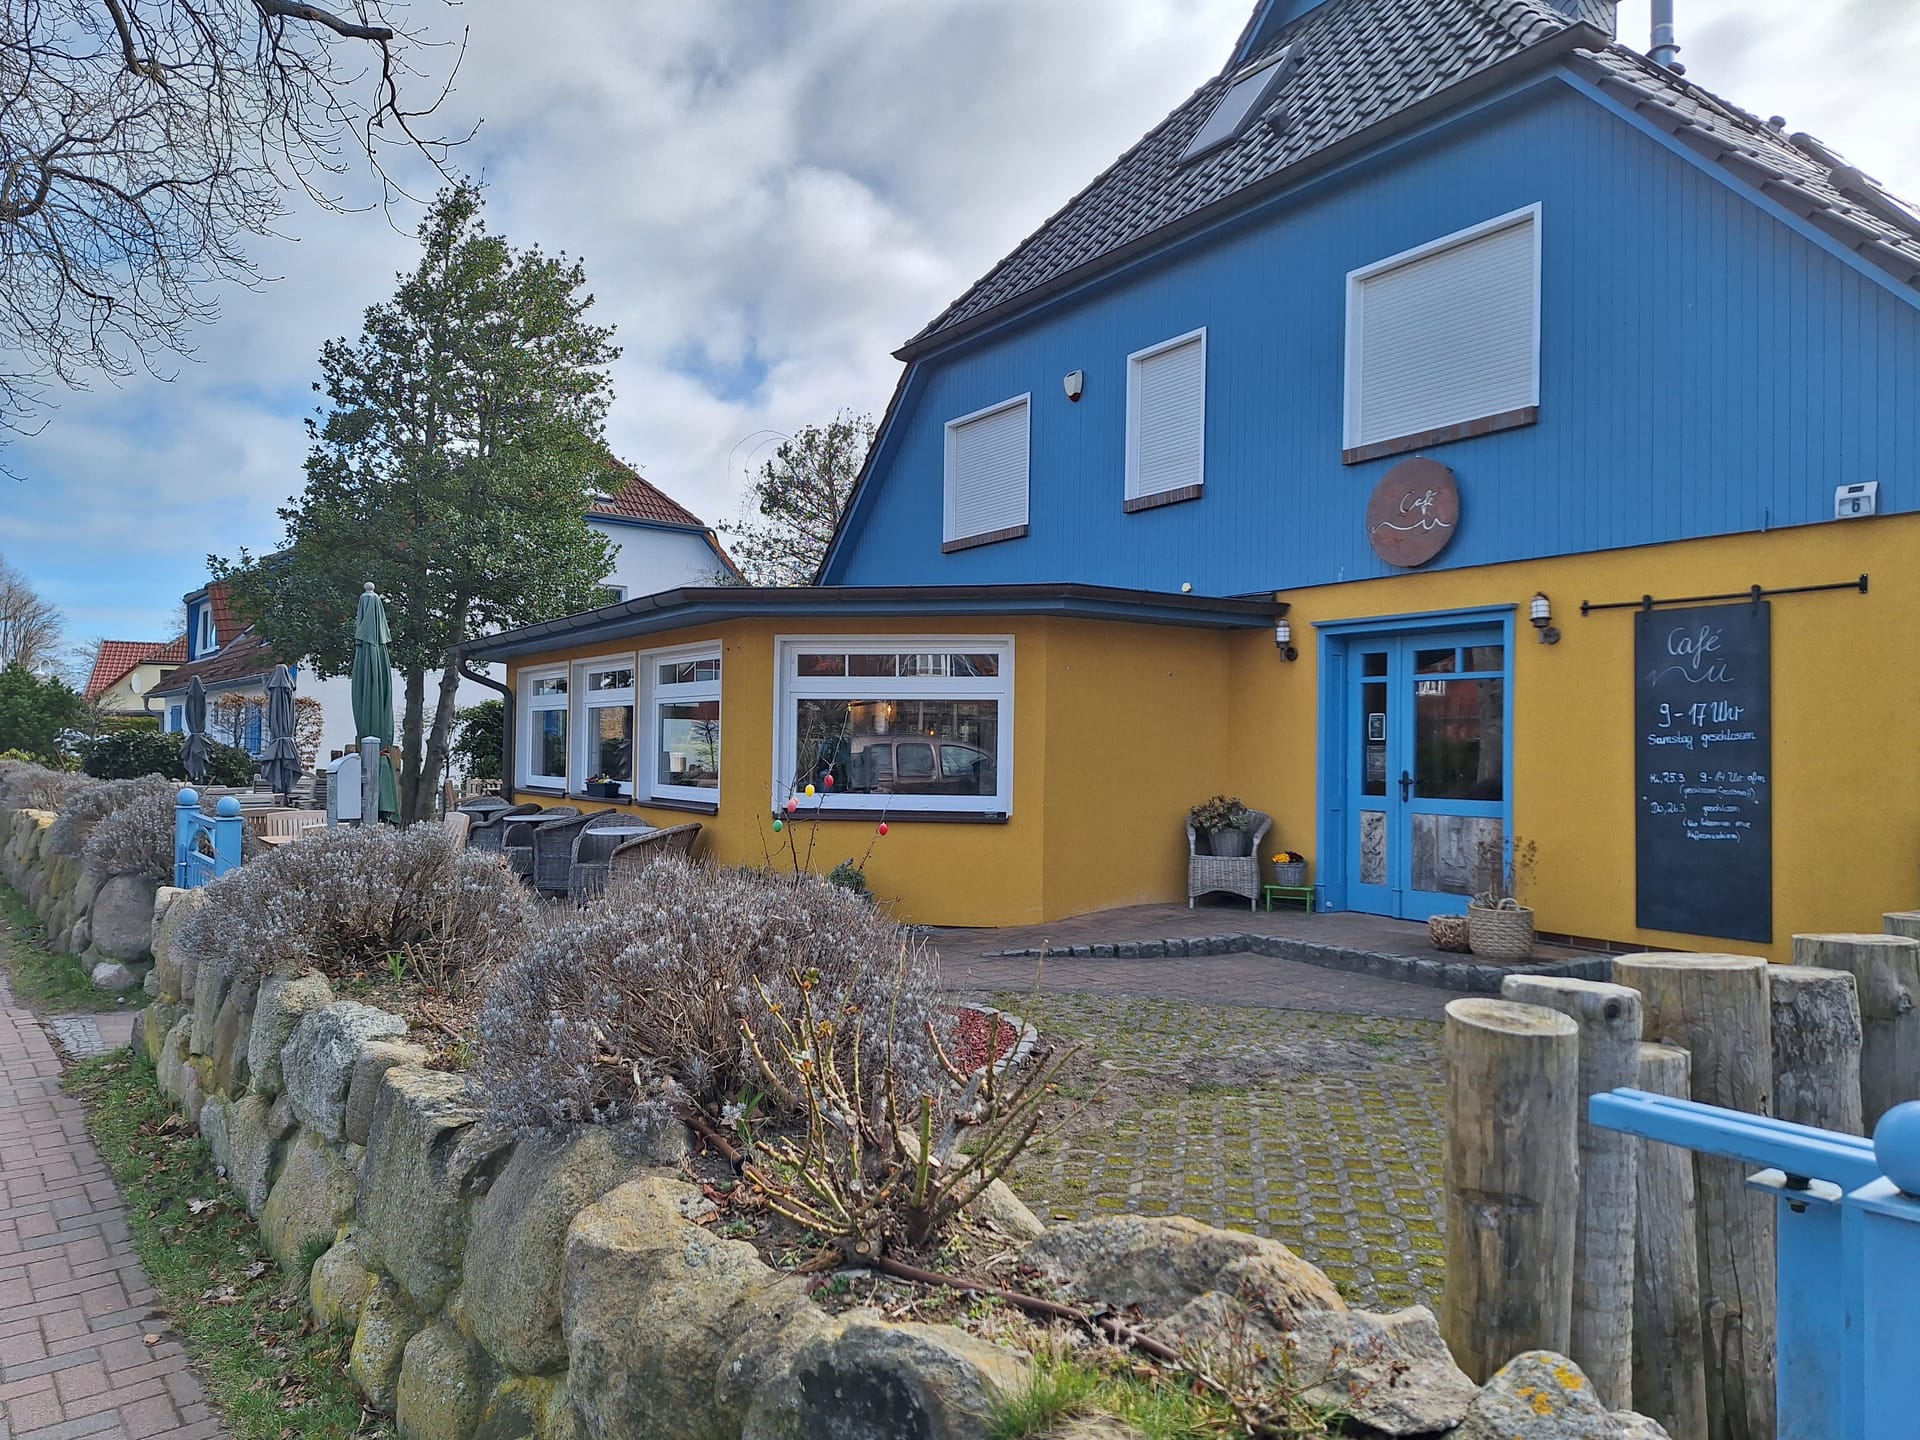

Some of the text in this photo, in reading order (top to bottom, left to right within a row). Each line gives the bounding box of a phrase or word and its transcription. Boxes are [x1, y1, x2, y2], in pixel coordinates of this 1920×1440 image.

[1400, 490, 1438, 515] Café
[1851, 498, 1861, 513] 6
[1668, 625, 1722, 669] Café
[1711, 700, 1744, 722] Uhr
[1648, 731, 1693, 750] Samstag
